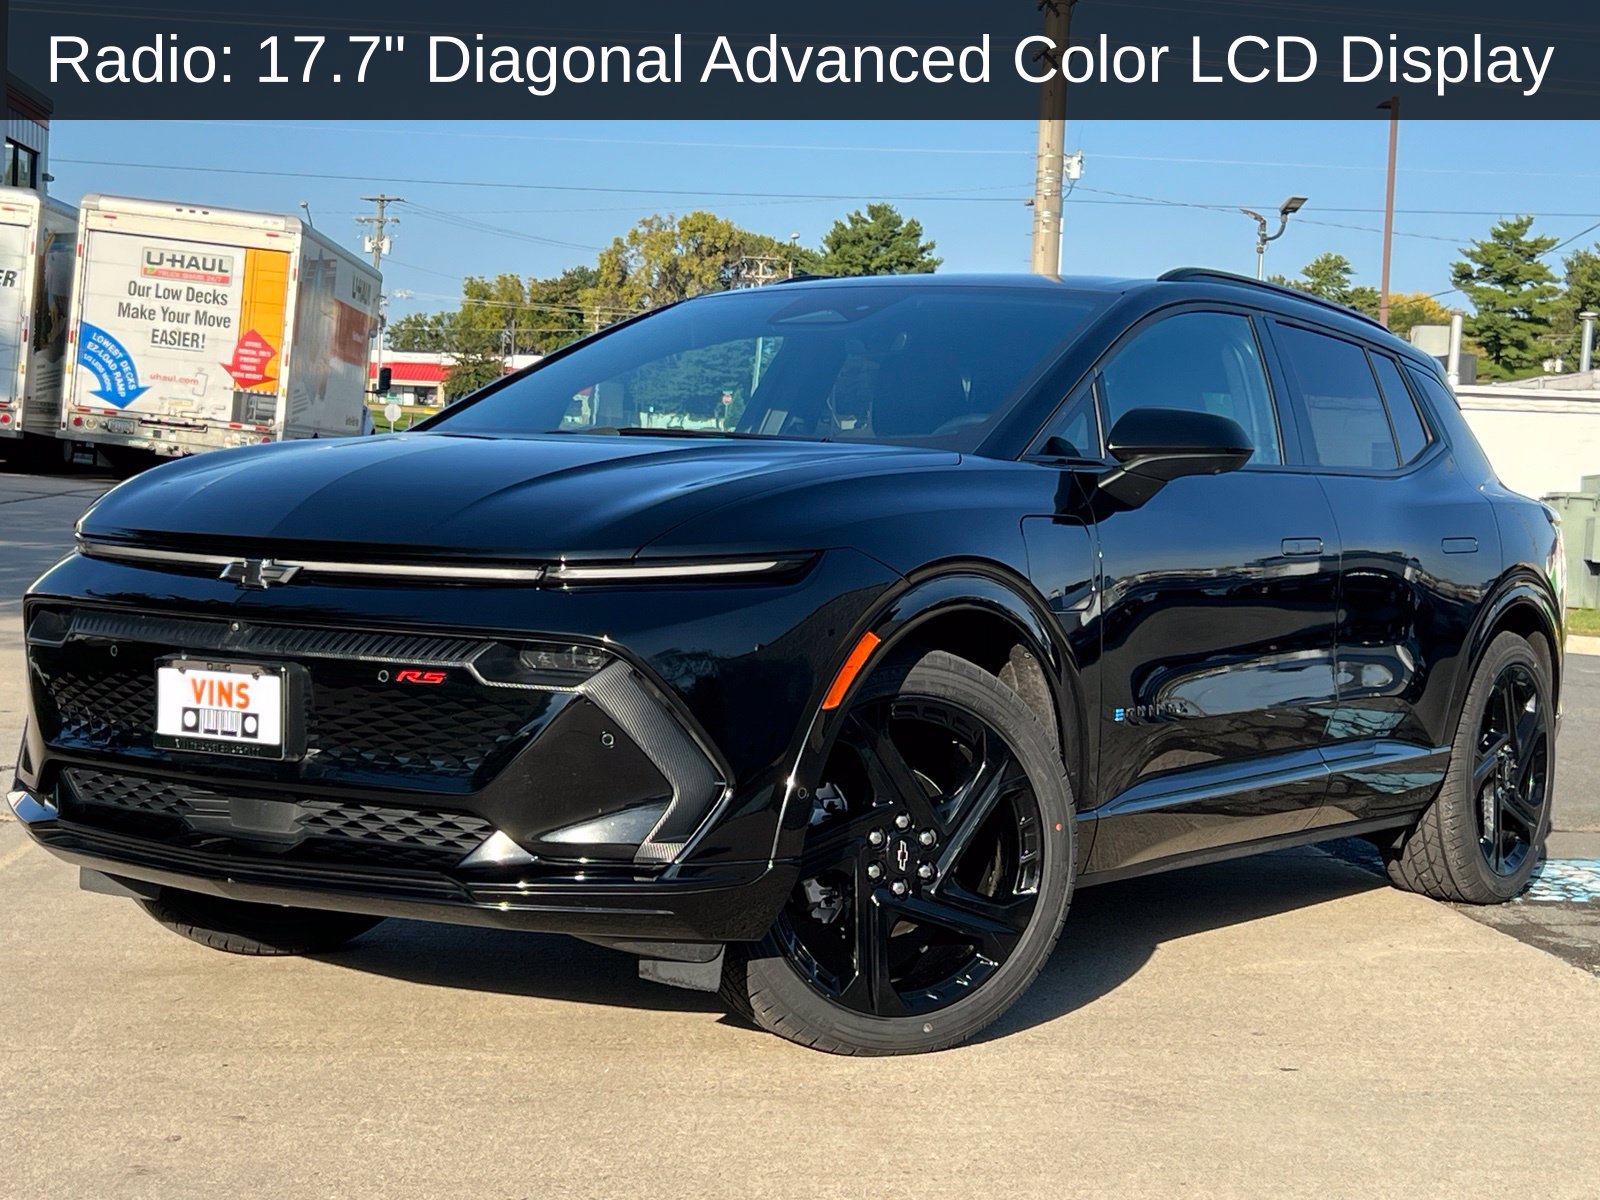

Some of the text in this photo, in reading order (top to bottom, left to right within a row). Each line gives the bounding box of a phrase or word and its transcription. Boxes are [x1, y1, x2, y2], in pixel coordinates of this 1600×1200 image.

[146, 250, 229, 273] U-HAUL
[128, 280, 229, 306] Our Low Decks
[117, 301, 231, 329] Make Your Move
[150, 327, 207, 349] EASIER!
[86, 341, 118, 371] EZ-LOAD
[112, 370, 127, 398] RAMP
[92, 332, 124, 360] LOWEST
[120, 360, 137, 391] DECKS
[101, 371, 113, 392] WORK
[149, 372, 200, 386] uhaul.com
[395, 669, 448, 685] RS
[191, 678, 250, 709] VINS
